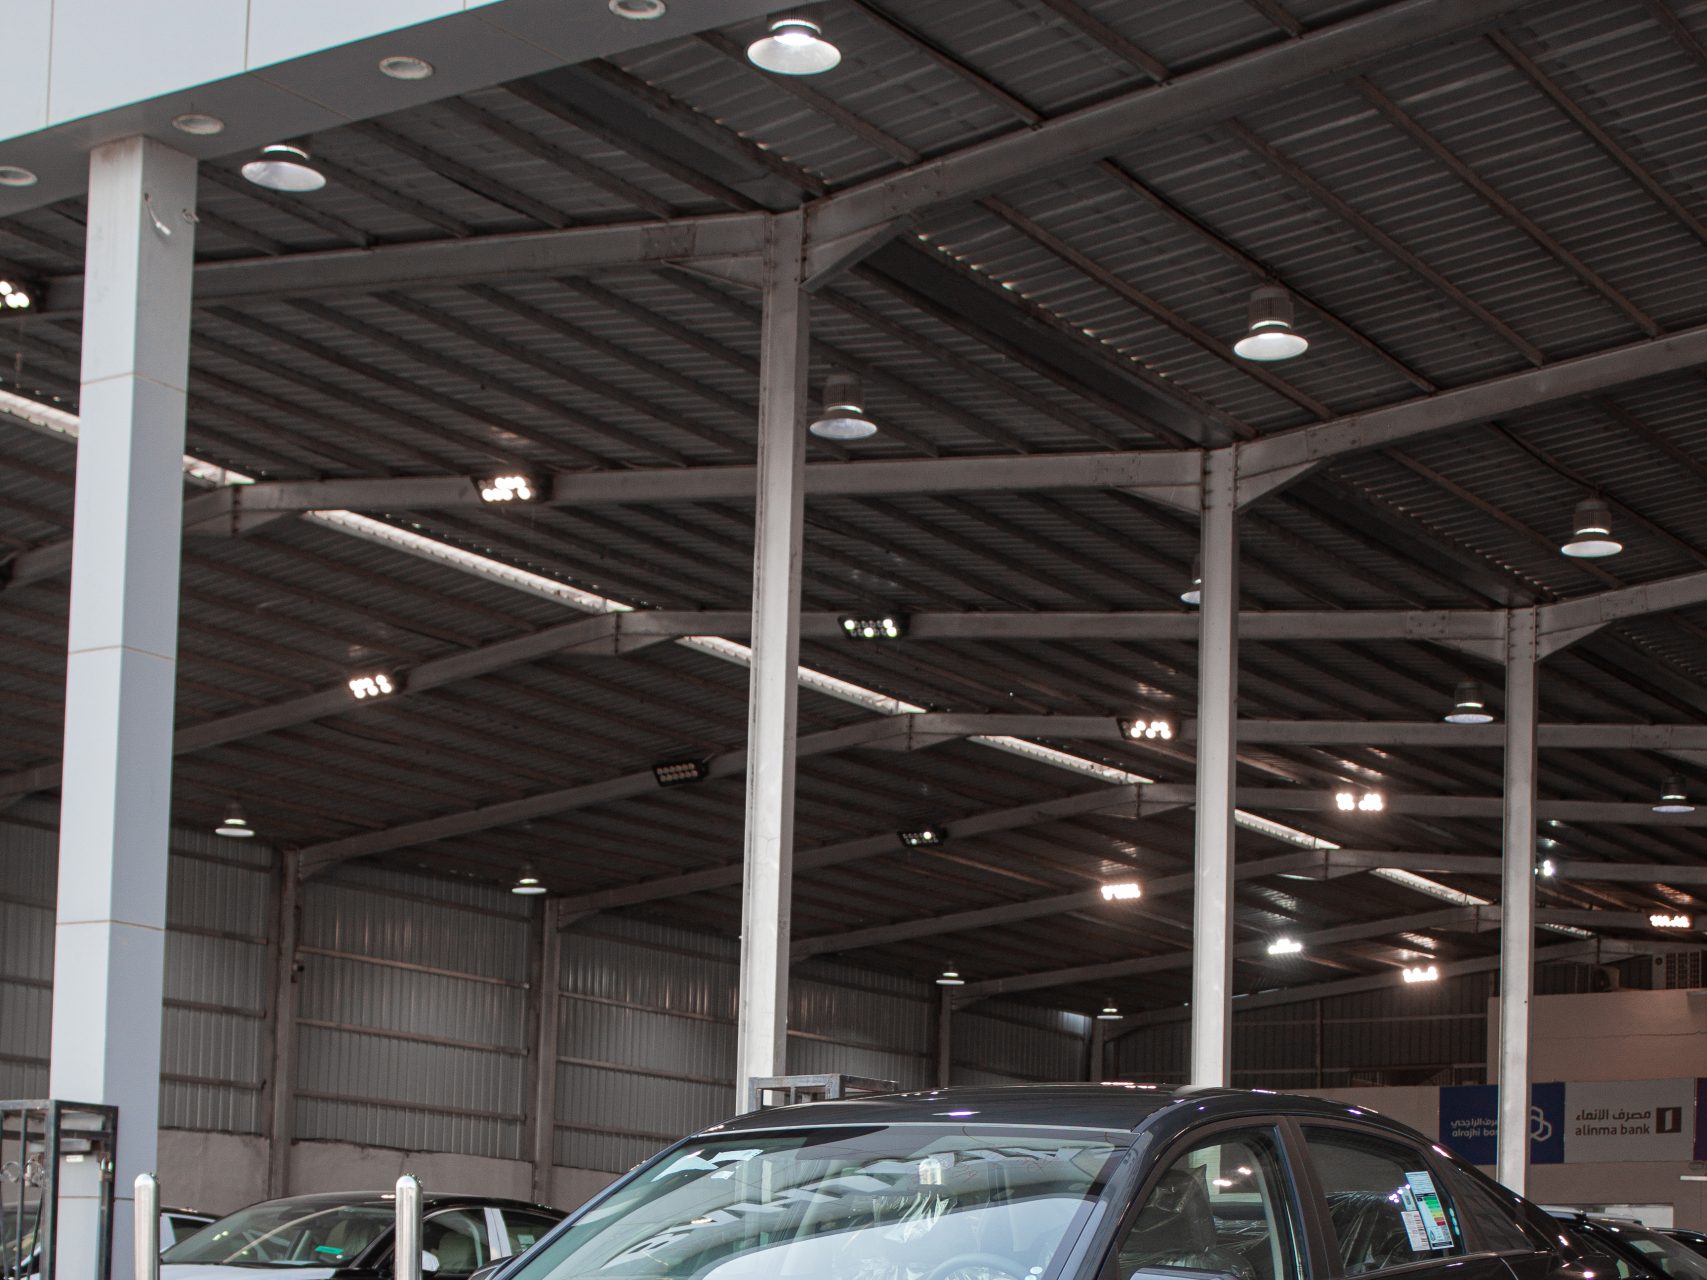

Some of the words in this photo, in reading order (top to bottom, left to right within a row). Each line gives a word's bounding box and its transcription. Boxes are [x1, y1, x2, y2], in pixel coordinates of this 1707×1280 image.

[1612, 1109, 1651, 1122] مصرف
[1451, 1128, 1481, 1140] alrajhi
[1575, 1124, 1617, 1136] alinma
[1621, 1123, 1651, 1135] bank
